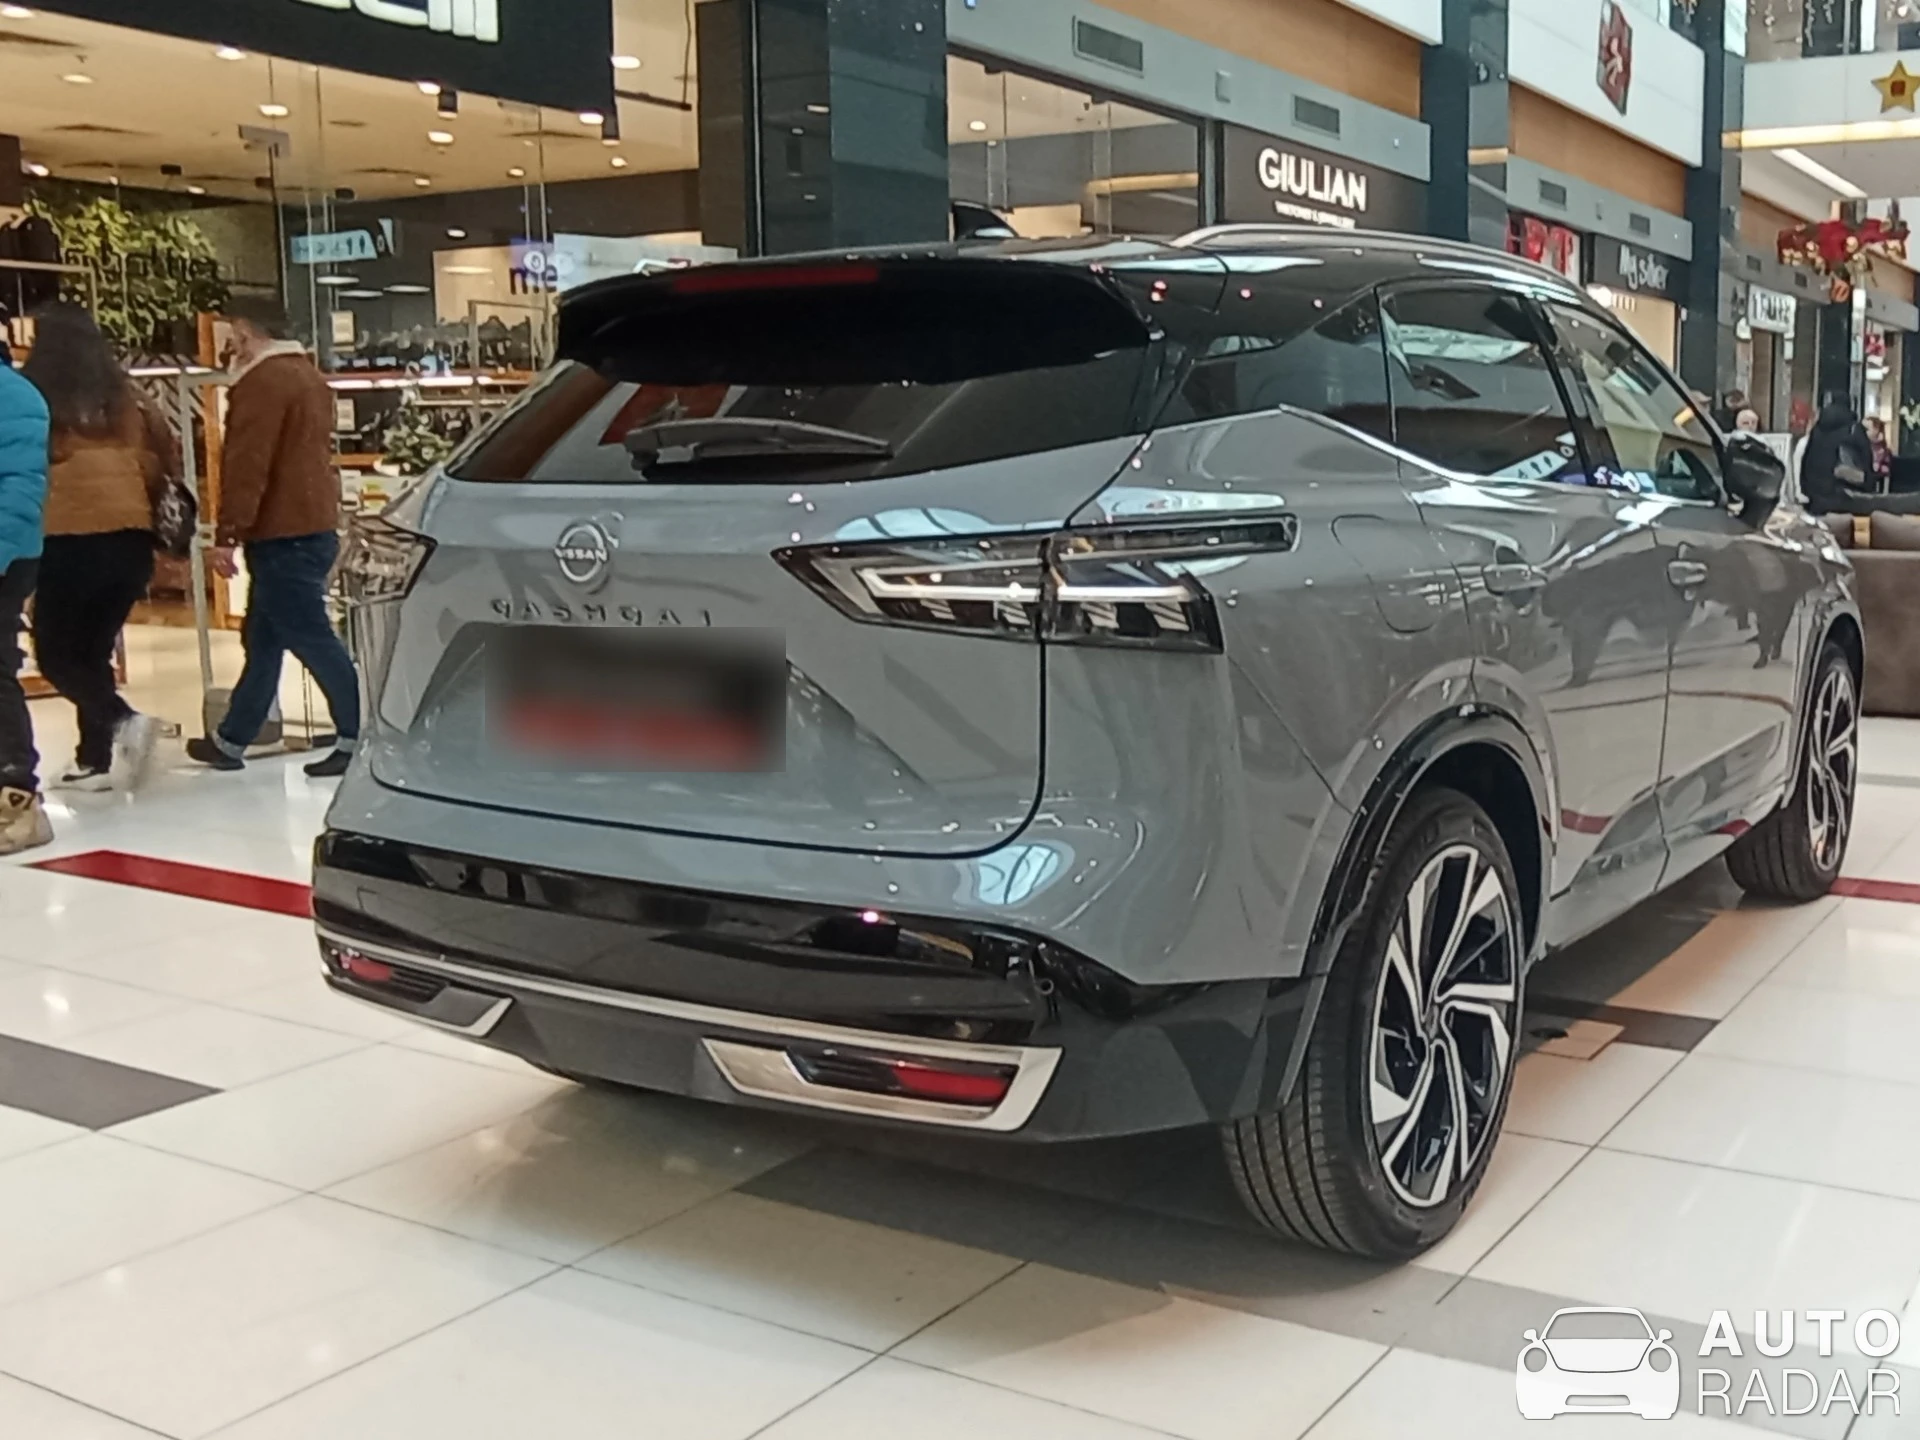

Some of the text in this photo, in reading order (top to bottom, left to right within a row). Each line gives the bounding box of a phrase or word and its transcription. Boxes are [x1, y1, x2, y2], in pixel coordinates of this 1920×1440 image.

[1258, 147, 1367, 212] GIULIAN
[554, 548, 608, 562] NISSAN
[491, 598, 712, 627] QASHQAI
